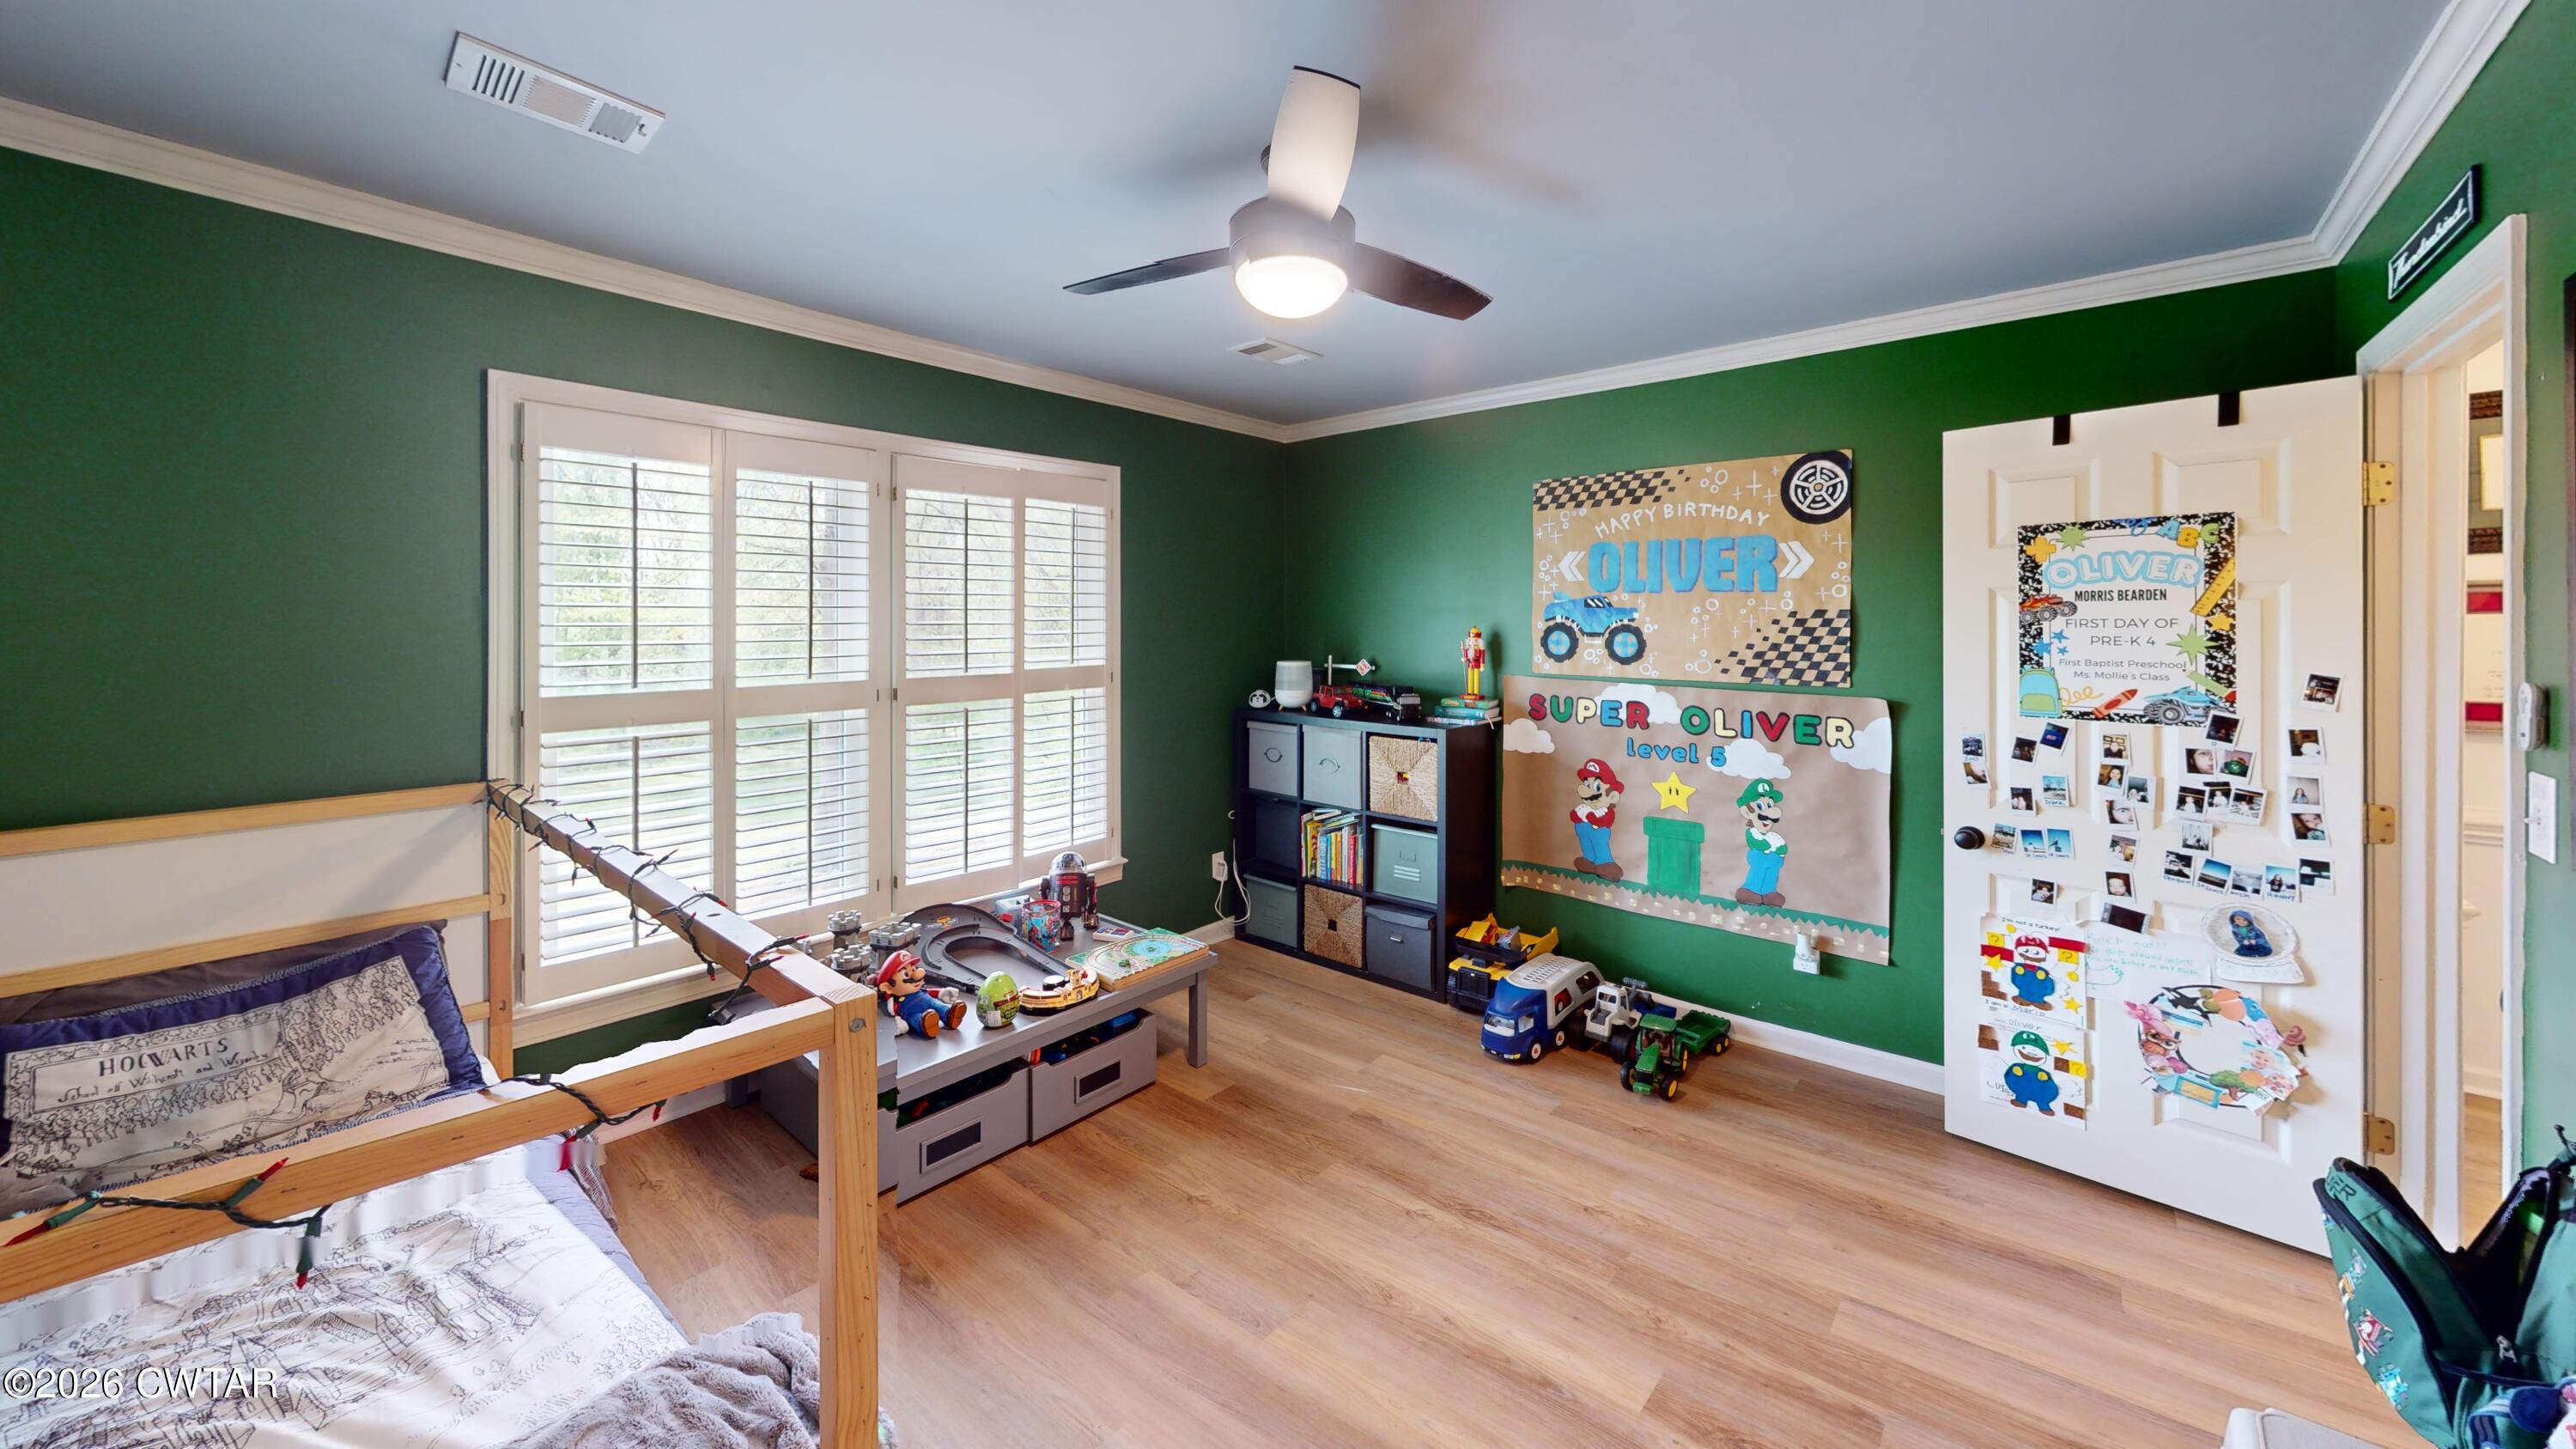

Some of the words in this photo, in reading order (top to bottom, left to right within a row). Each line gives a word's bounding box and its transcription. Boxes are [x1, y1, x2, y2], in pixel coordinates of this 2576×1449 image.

[1595, 505, 1657, 539] HAPPY
[1663, 501, 1771, 527] BIRTHDAY
[1587, 533, 1779, 594] OLIVER
[2044, 551, 2202, 588] OLIVER
[2075, 589, 2114, 602] MORRIS
[2117, 588, 2167, 601] BEARDEN
[2065, 618, 2109, 629] FIRST
[2114, 618, 2149, 629] DAY
[2154, 618, 2179, 629] OF
[2090, 636, 2141, 646] PRE-K
[2146, 636, 2156, 646] 4
[2059, 658, 2081, 667] First
[2085, 658, 2123, 670] Baptist
[2128, 660, 2186, 670] Preschool
[2094, 671, 2138, 681] Mollie's
[2140, 672, 2171, 682] Class
[1528, 692, 1650, 730] SUPER
[1680, 705, 1855, 749] OLIVER
[1626, 737, 1699, 765] level
[1710, 746, 1728, 768] 5
[196, 1062, 213, 1074] and
